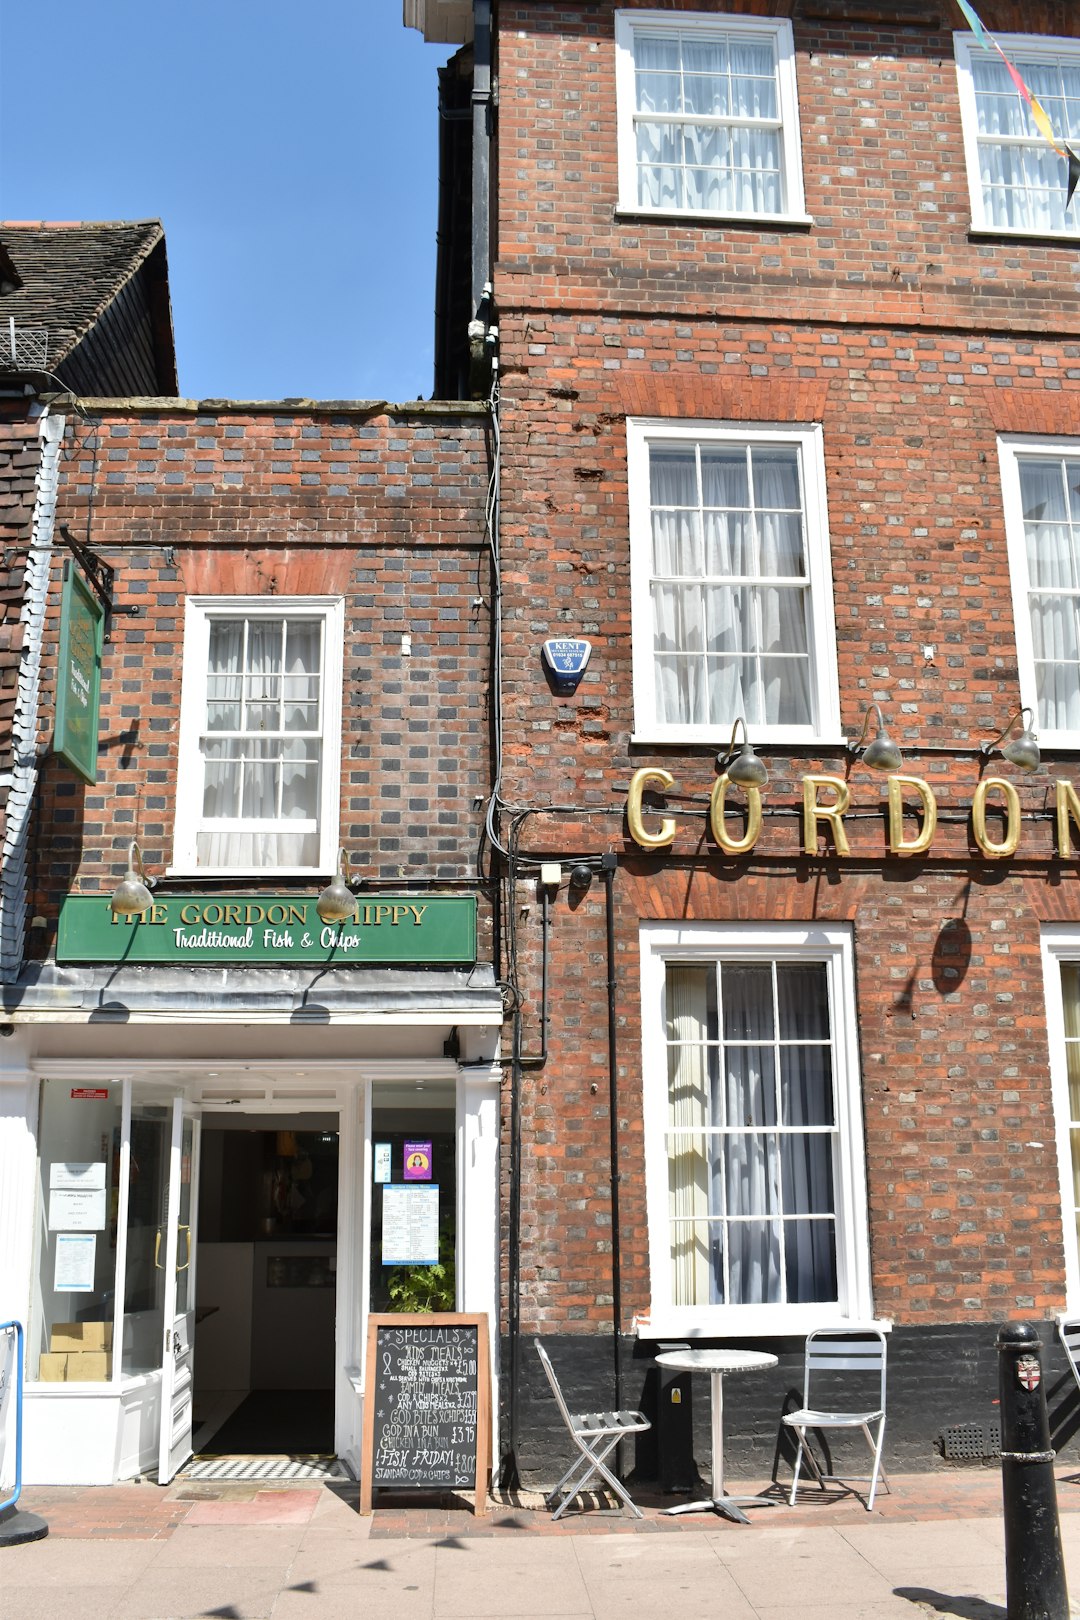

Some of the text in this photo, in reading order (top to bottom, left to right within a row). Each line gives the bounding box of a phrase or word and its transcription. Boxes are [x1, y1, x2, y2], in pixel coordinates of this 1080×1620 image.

[555, 642, 580, 650] KENT
[180, 904, 308, 926] GORDON
[172, 926, 361, 952] Traditional Fish & Chips
[395, 1328, 460, 1344] SPECIALS
[405, 1345, 463, 1361] KIDS MEALS
[396, 1358, 420, 1366] CHICKEN
[422, 1359, 449, 1367] NUGGETS
[400, 1382, 460, 1396] FAMILY MEALS
[397, 1393, 410, 1402] COD
[418, 1393, 439, 1402] CHIPS
[397, 1401, 413, 1410] ANY
[412, 1410, 439, 1426] BITES
[421, 1425, 439, 1438] BUN
[380, 1437, 414, 1450] CHICKEN
[435, 1437, 449, 1450] BUN
[375, 1468, 408, 1479] STANDARD
[428, 1470, 450, 1480] CHIPS
